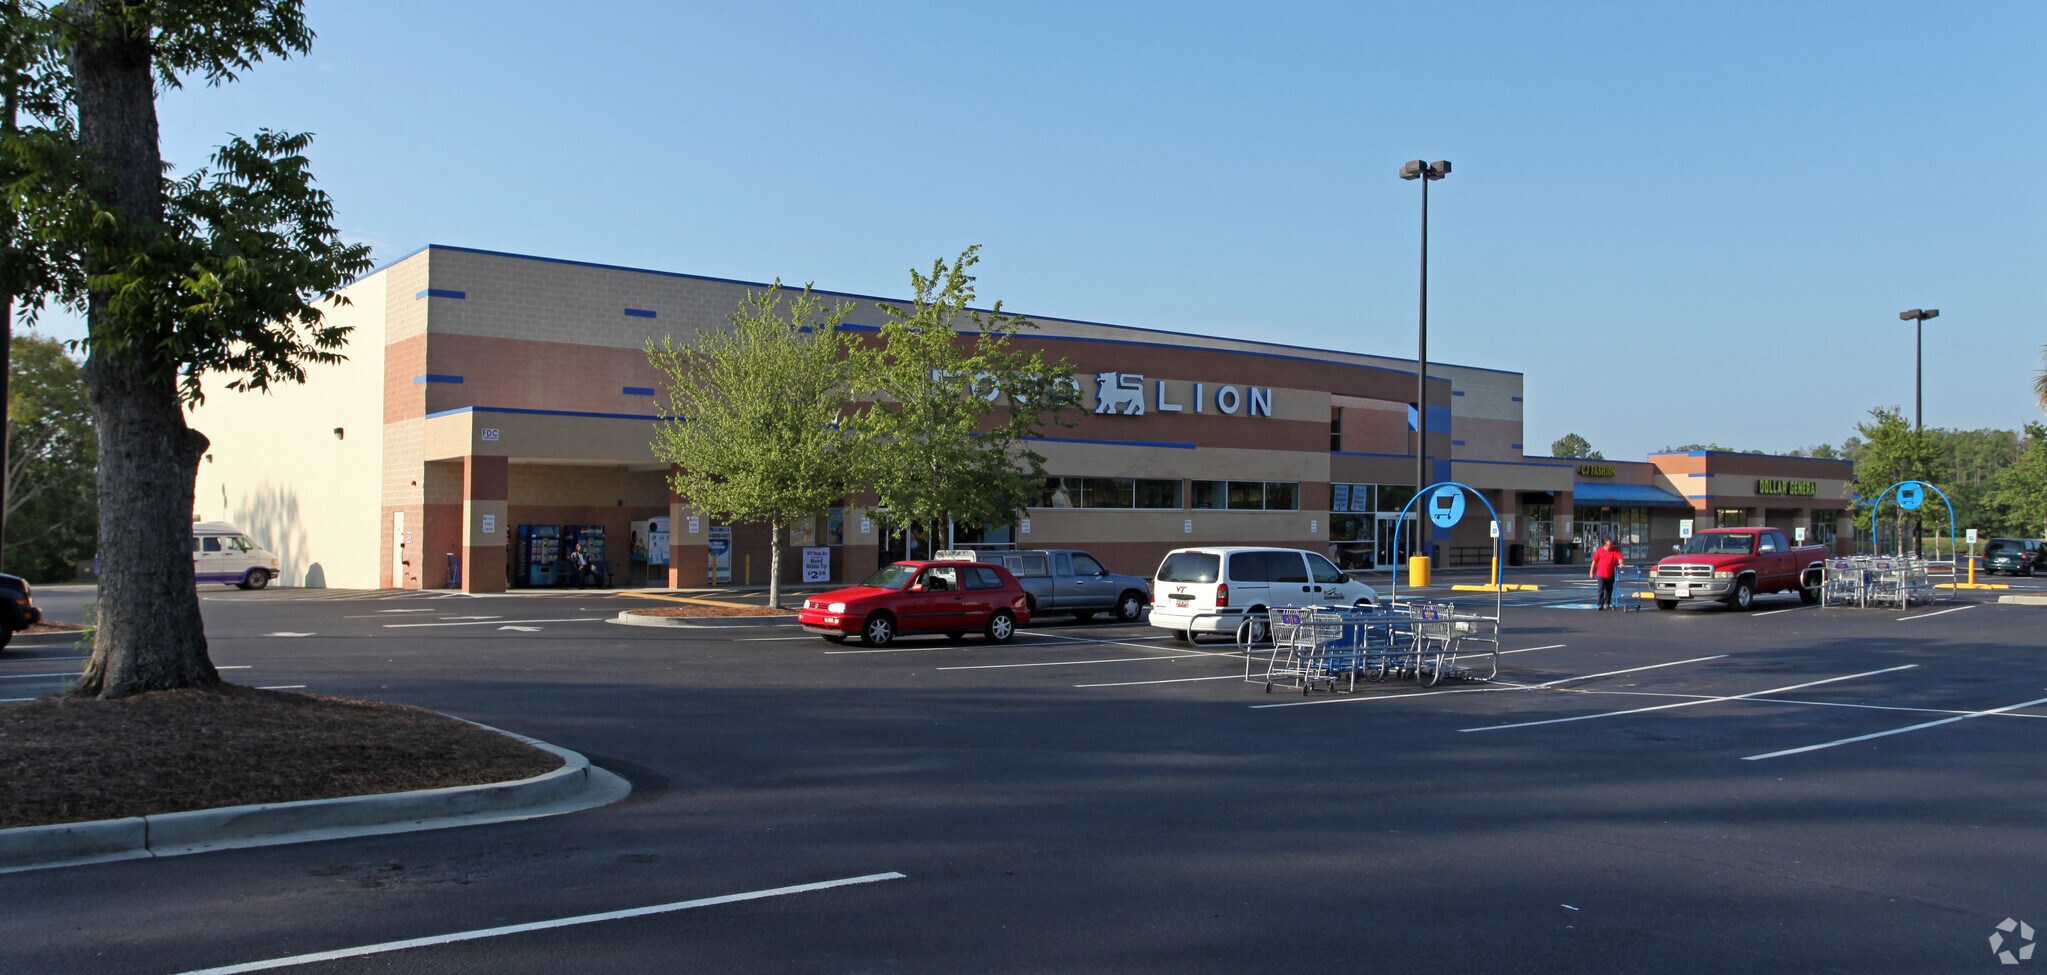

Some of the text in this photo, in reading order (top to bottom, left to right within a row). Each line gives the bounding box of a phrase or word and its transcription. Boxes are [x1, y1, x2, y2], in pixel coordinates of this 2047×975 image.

[1156, 380, 1273, 417] LION
[1760, 479, 1818, 495] DOLLAR GENERAL
